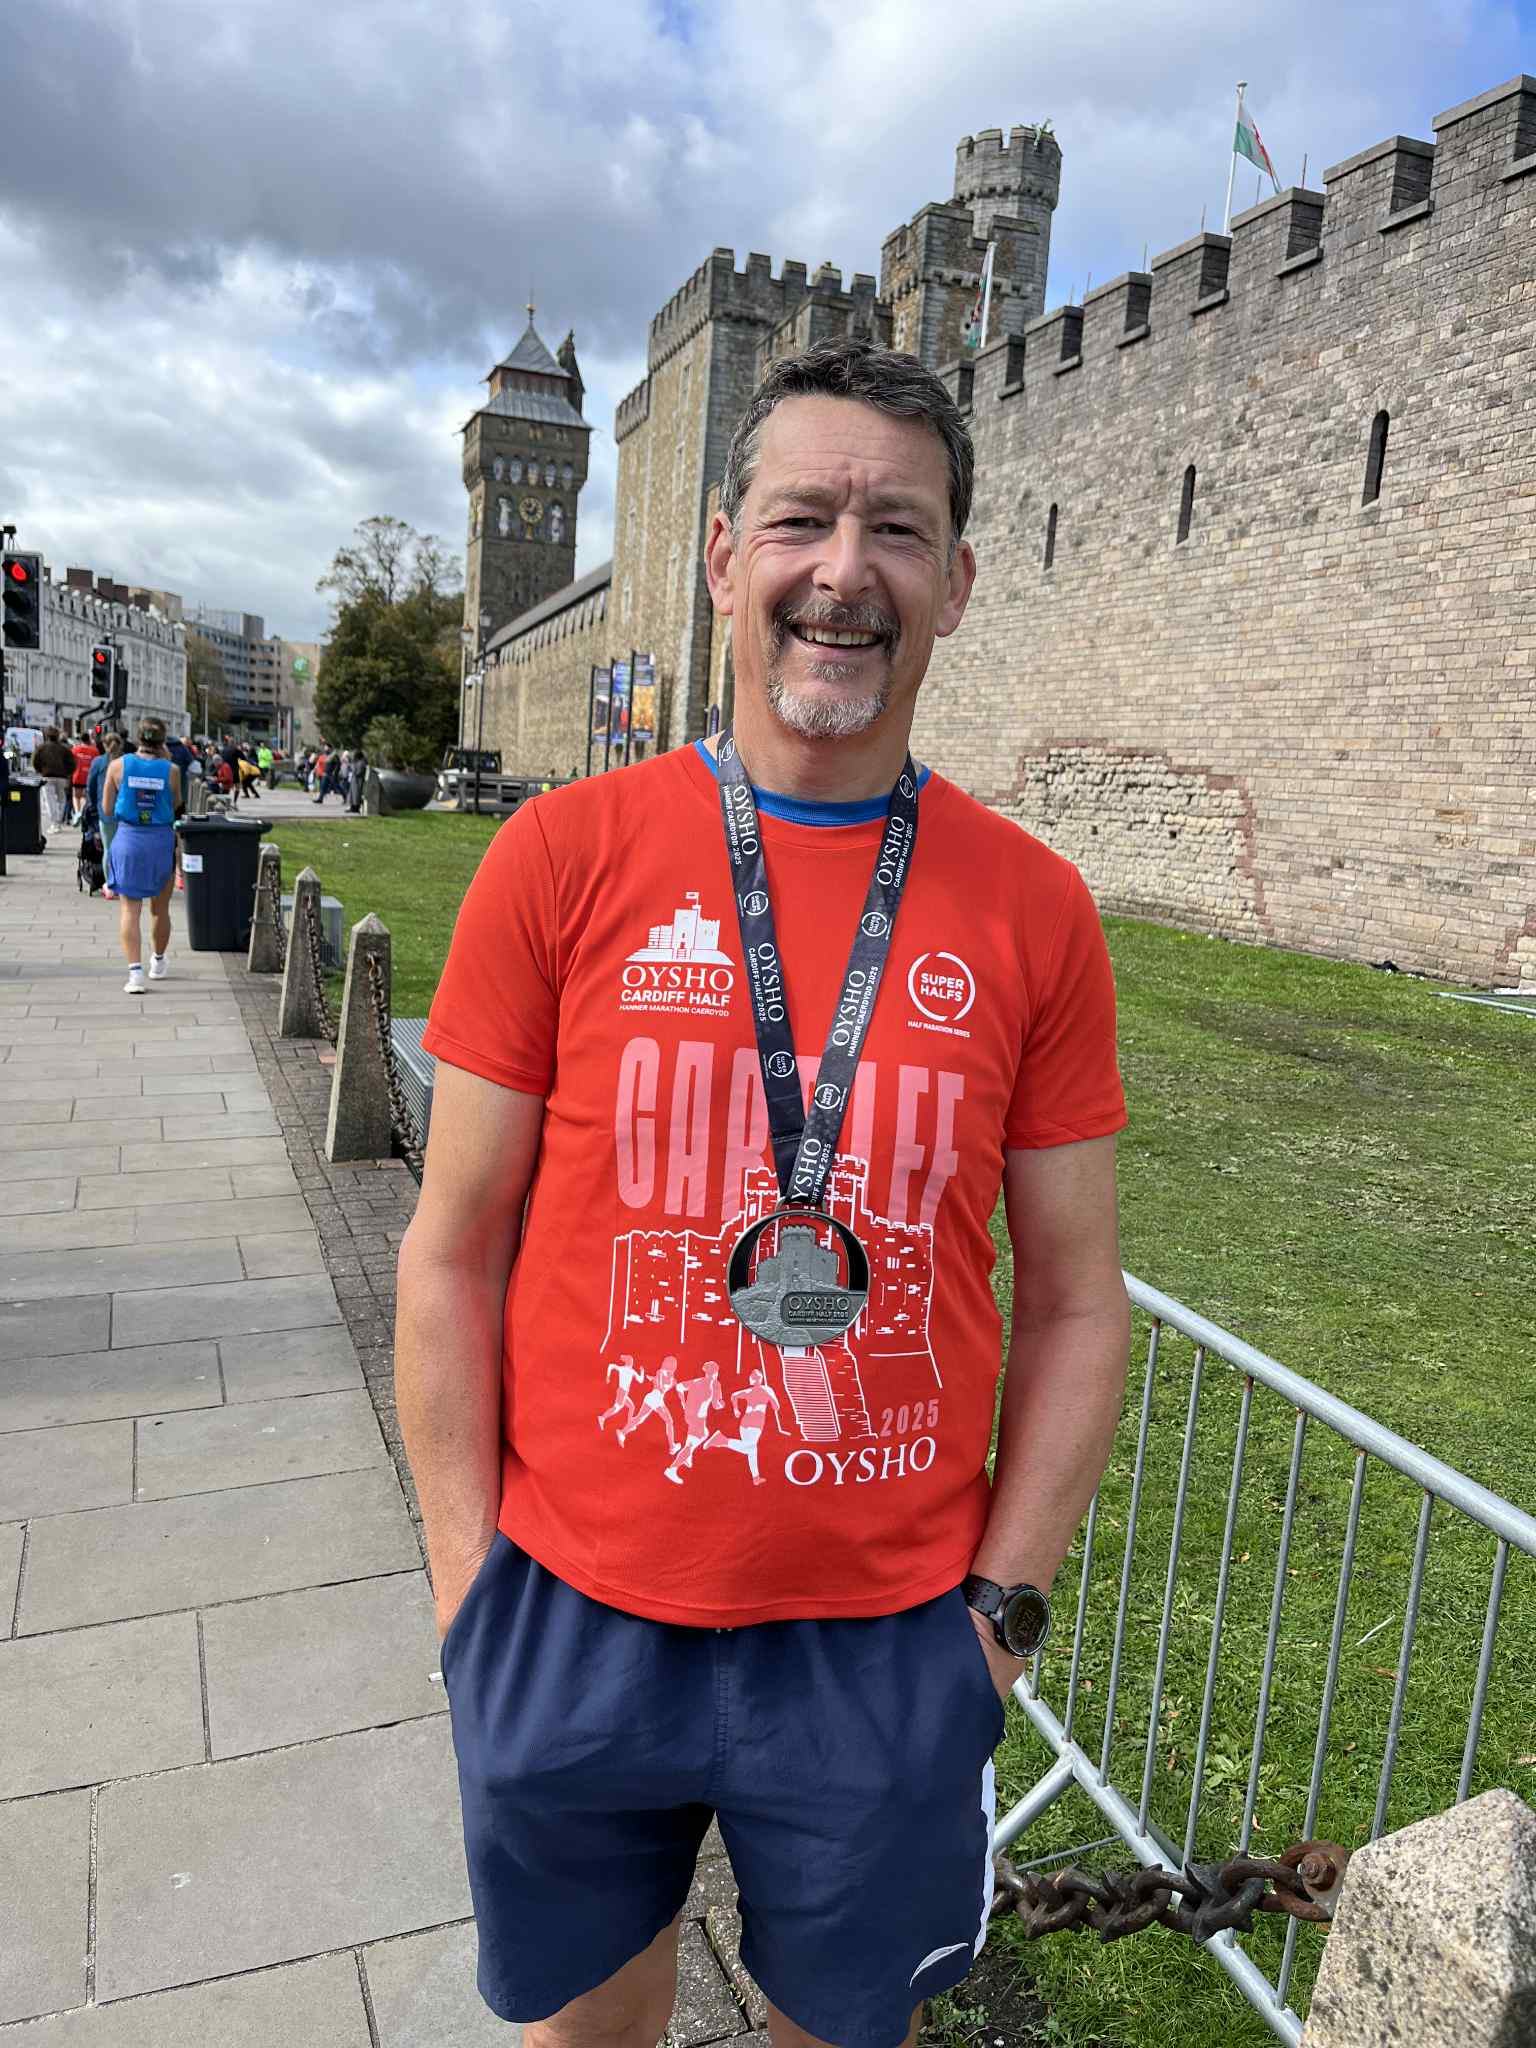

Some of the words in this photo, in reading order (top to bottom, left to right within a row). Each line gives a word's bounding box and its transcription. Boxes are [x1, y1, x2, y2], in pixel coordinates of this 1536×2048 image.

[722, 784, 732, 811] HANNER
[727, 808, 739, 846] CAERDYDD
[733, 785, 758, 856] OYSHO
[906, 823, 914, 839] 2025
[732, 847, 743, 865] 2025
[876, 816, 906, 886] OYSHO
[902, 838, 911, 860] HALF
[893, 858, 907, 889] CARDIFF
[748, 947, 759, 980] CARDIFF
[622, 965, 734, 992] OYSHO
[753, 978, 763, 1003] HALF
[757, 942, 785, 1023] OYSHO
[920, 973, 965, 991] SUPER
[621, 989, 686, 1003] CARDIFF
[689, 992, 731, 1007] HALF
[920, 984, 962, 1002] HALFS
[649, 1005, 690, 1014] MARATHON
[691, 1007, 729, 1017] CAERDYDD
[757, 1000, 767, 1022] 2025
[832, 969, 867, 1047] OYSHO
[847, 1025, 860, 1057] HANNER
[857, 984, 873, 1026] CAERDYDD
[867, 965, 879, 987] 2025
[907, 1020, 922, 1029] HALF
[615, 1037, 965, 1226] CARIFF
[820, 1143, 832, 1163] 2025
[791, 1138, 822, 1200] YSHO
[815, 1163, 826, 1186] HALF
[789, 1295, 850, 1311] OYSHO
[880, 1398, 941, 1438] 2025
[784, 1436, 937, 1487] OYSHO
